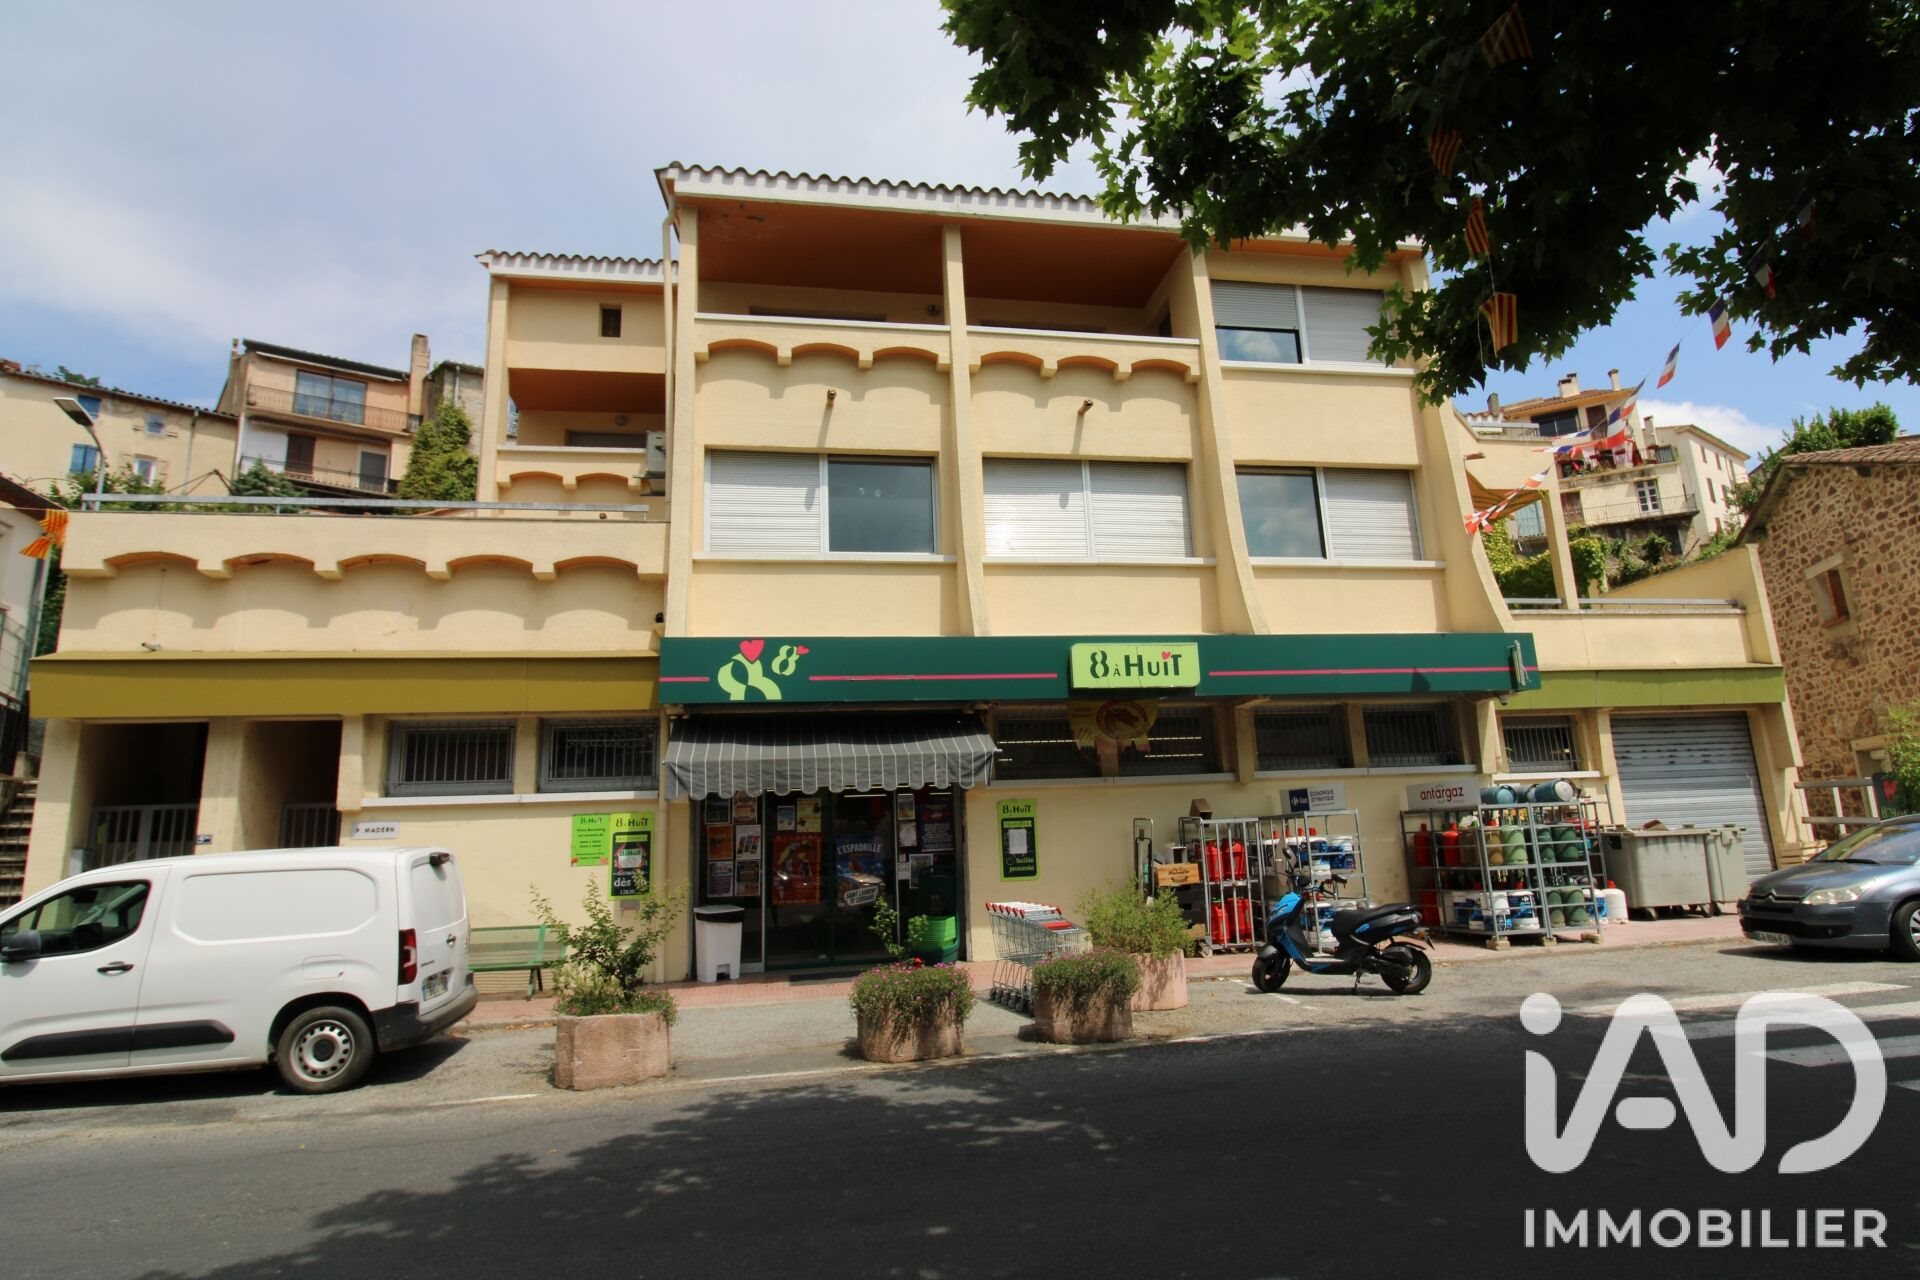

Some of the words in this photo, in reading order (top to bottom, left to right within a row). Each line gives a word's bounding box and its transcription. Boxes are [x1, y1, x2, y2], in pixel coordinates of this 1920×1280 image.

[1089, 650, 1110, 679] 8
[1420, 787, 1464, 802] antargaz
[613, 878, 632, 887] dès
